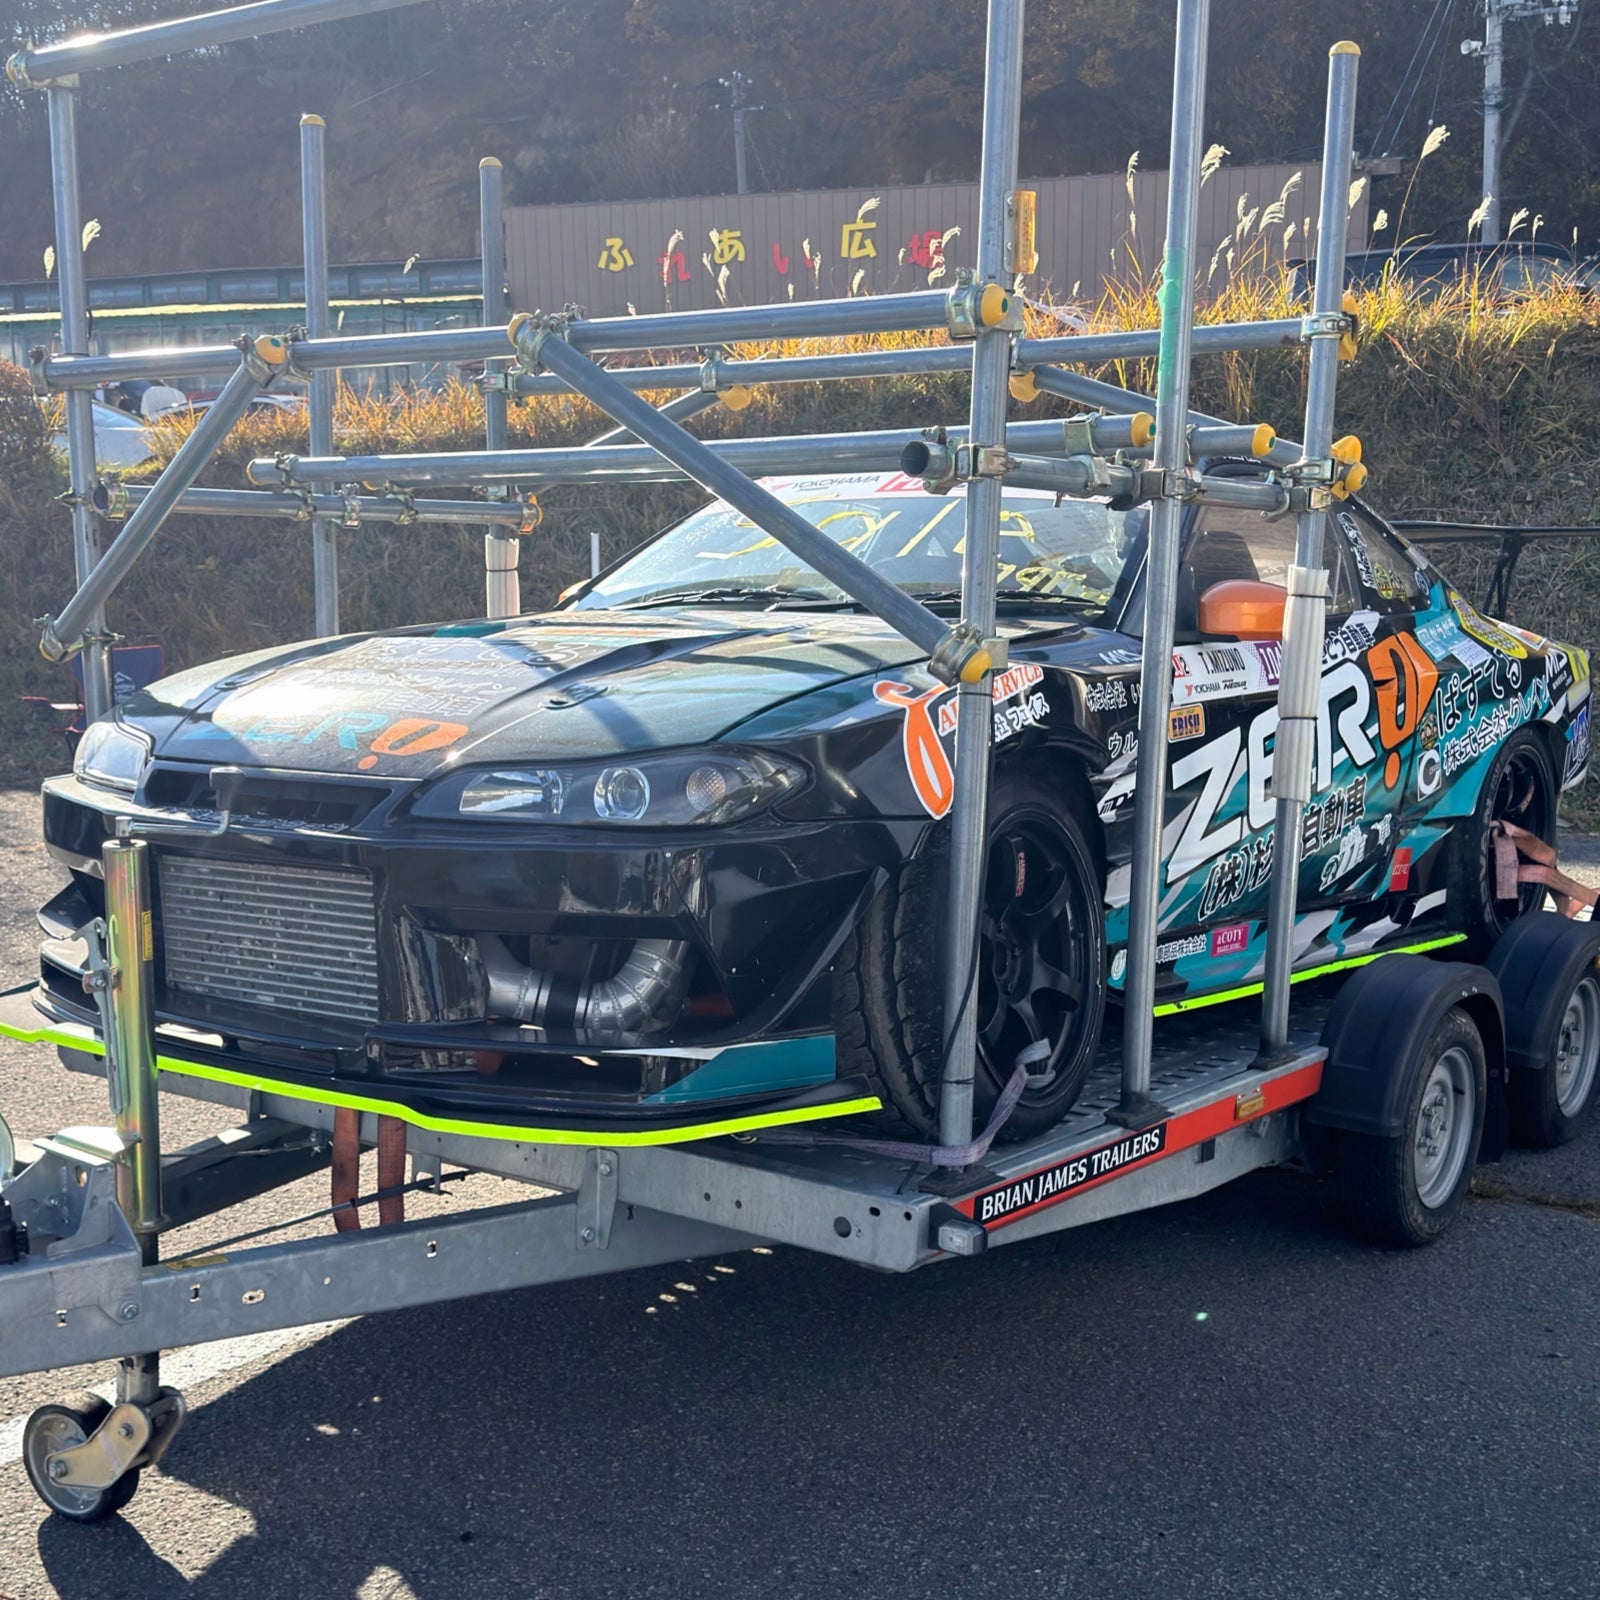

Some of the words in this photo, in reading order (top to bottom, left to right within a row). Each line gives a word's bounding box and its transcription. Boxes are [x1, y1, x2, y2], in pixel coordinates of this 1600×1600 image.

[598, 221, 945, 284] ふれあい広場
[992, 664, 1043, 702] ERVICE
[1198, 648, 1246, 674] T.MIZUNO
[1194, 683, 1221, 694] YOKOHAMA
[1436, 647, 1522, 739] ぱすてる
[981, 1178, 1034, 1220] BRIAN
[1035, 1158, 1088, 1203] JAMES
[1091, 1129, 1160, 1176] TRAILERS
